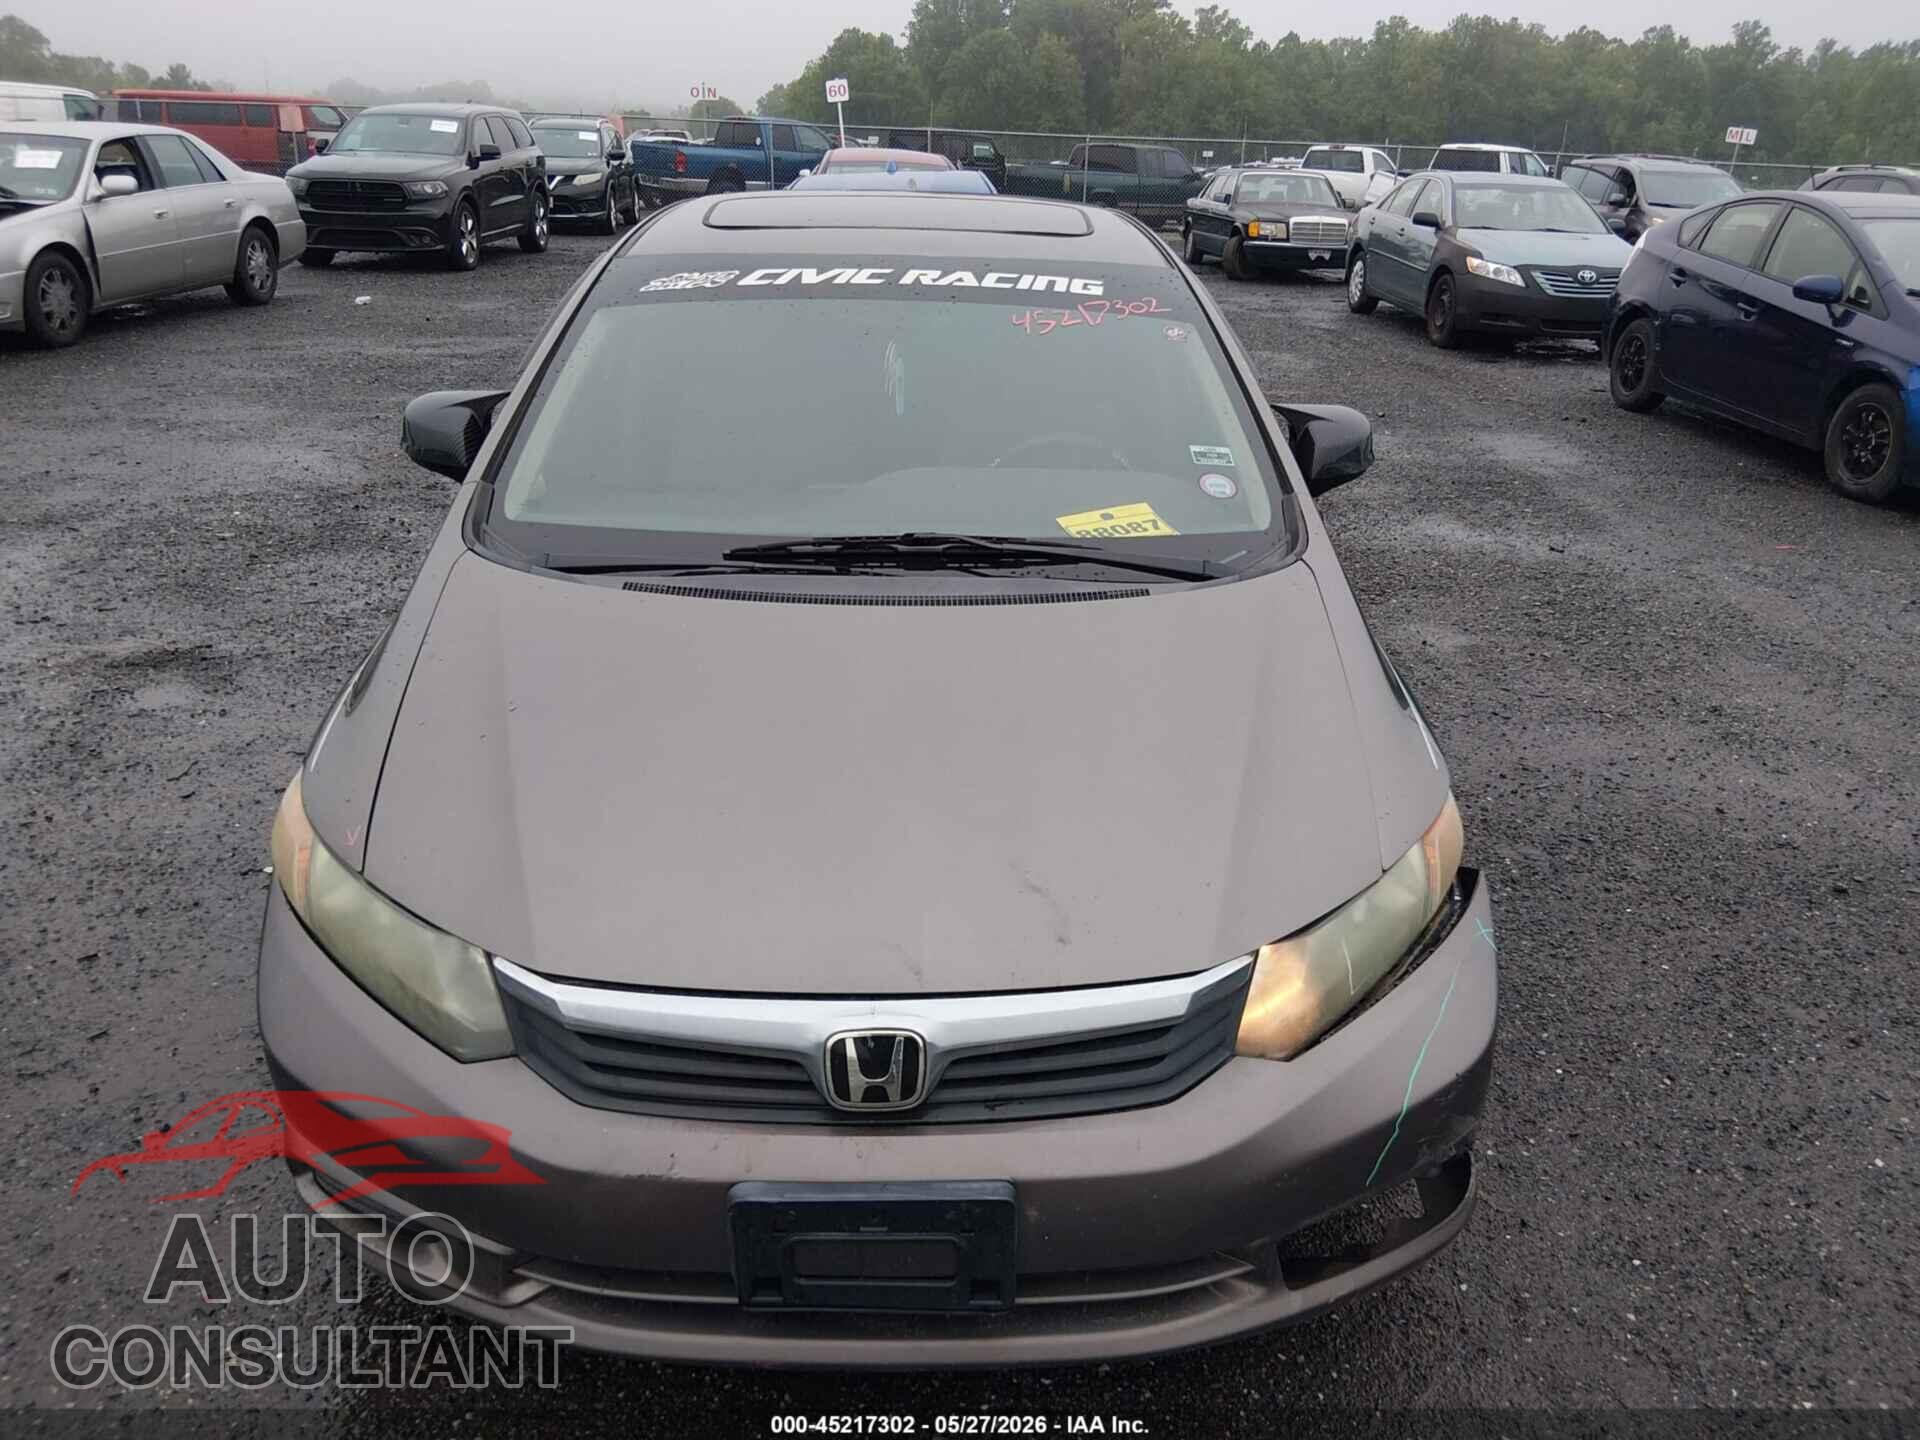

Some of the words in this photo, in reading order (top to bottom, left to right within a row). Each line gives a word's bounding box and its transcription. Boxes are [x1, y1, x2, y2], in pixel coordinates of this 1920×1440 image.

[828, 84, 847, 98] 60
[736, 268, 895, 286] CIVIC
[897, 269, 1104, 296] RACING
